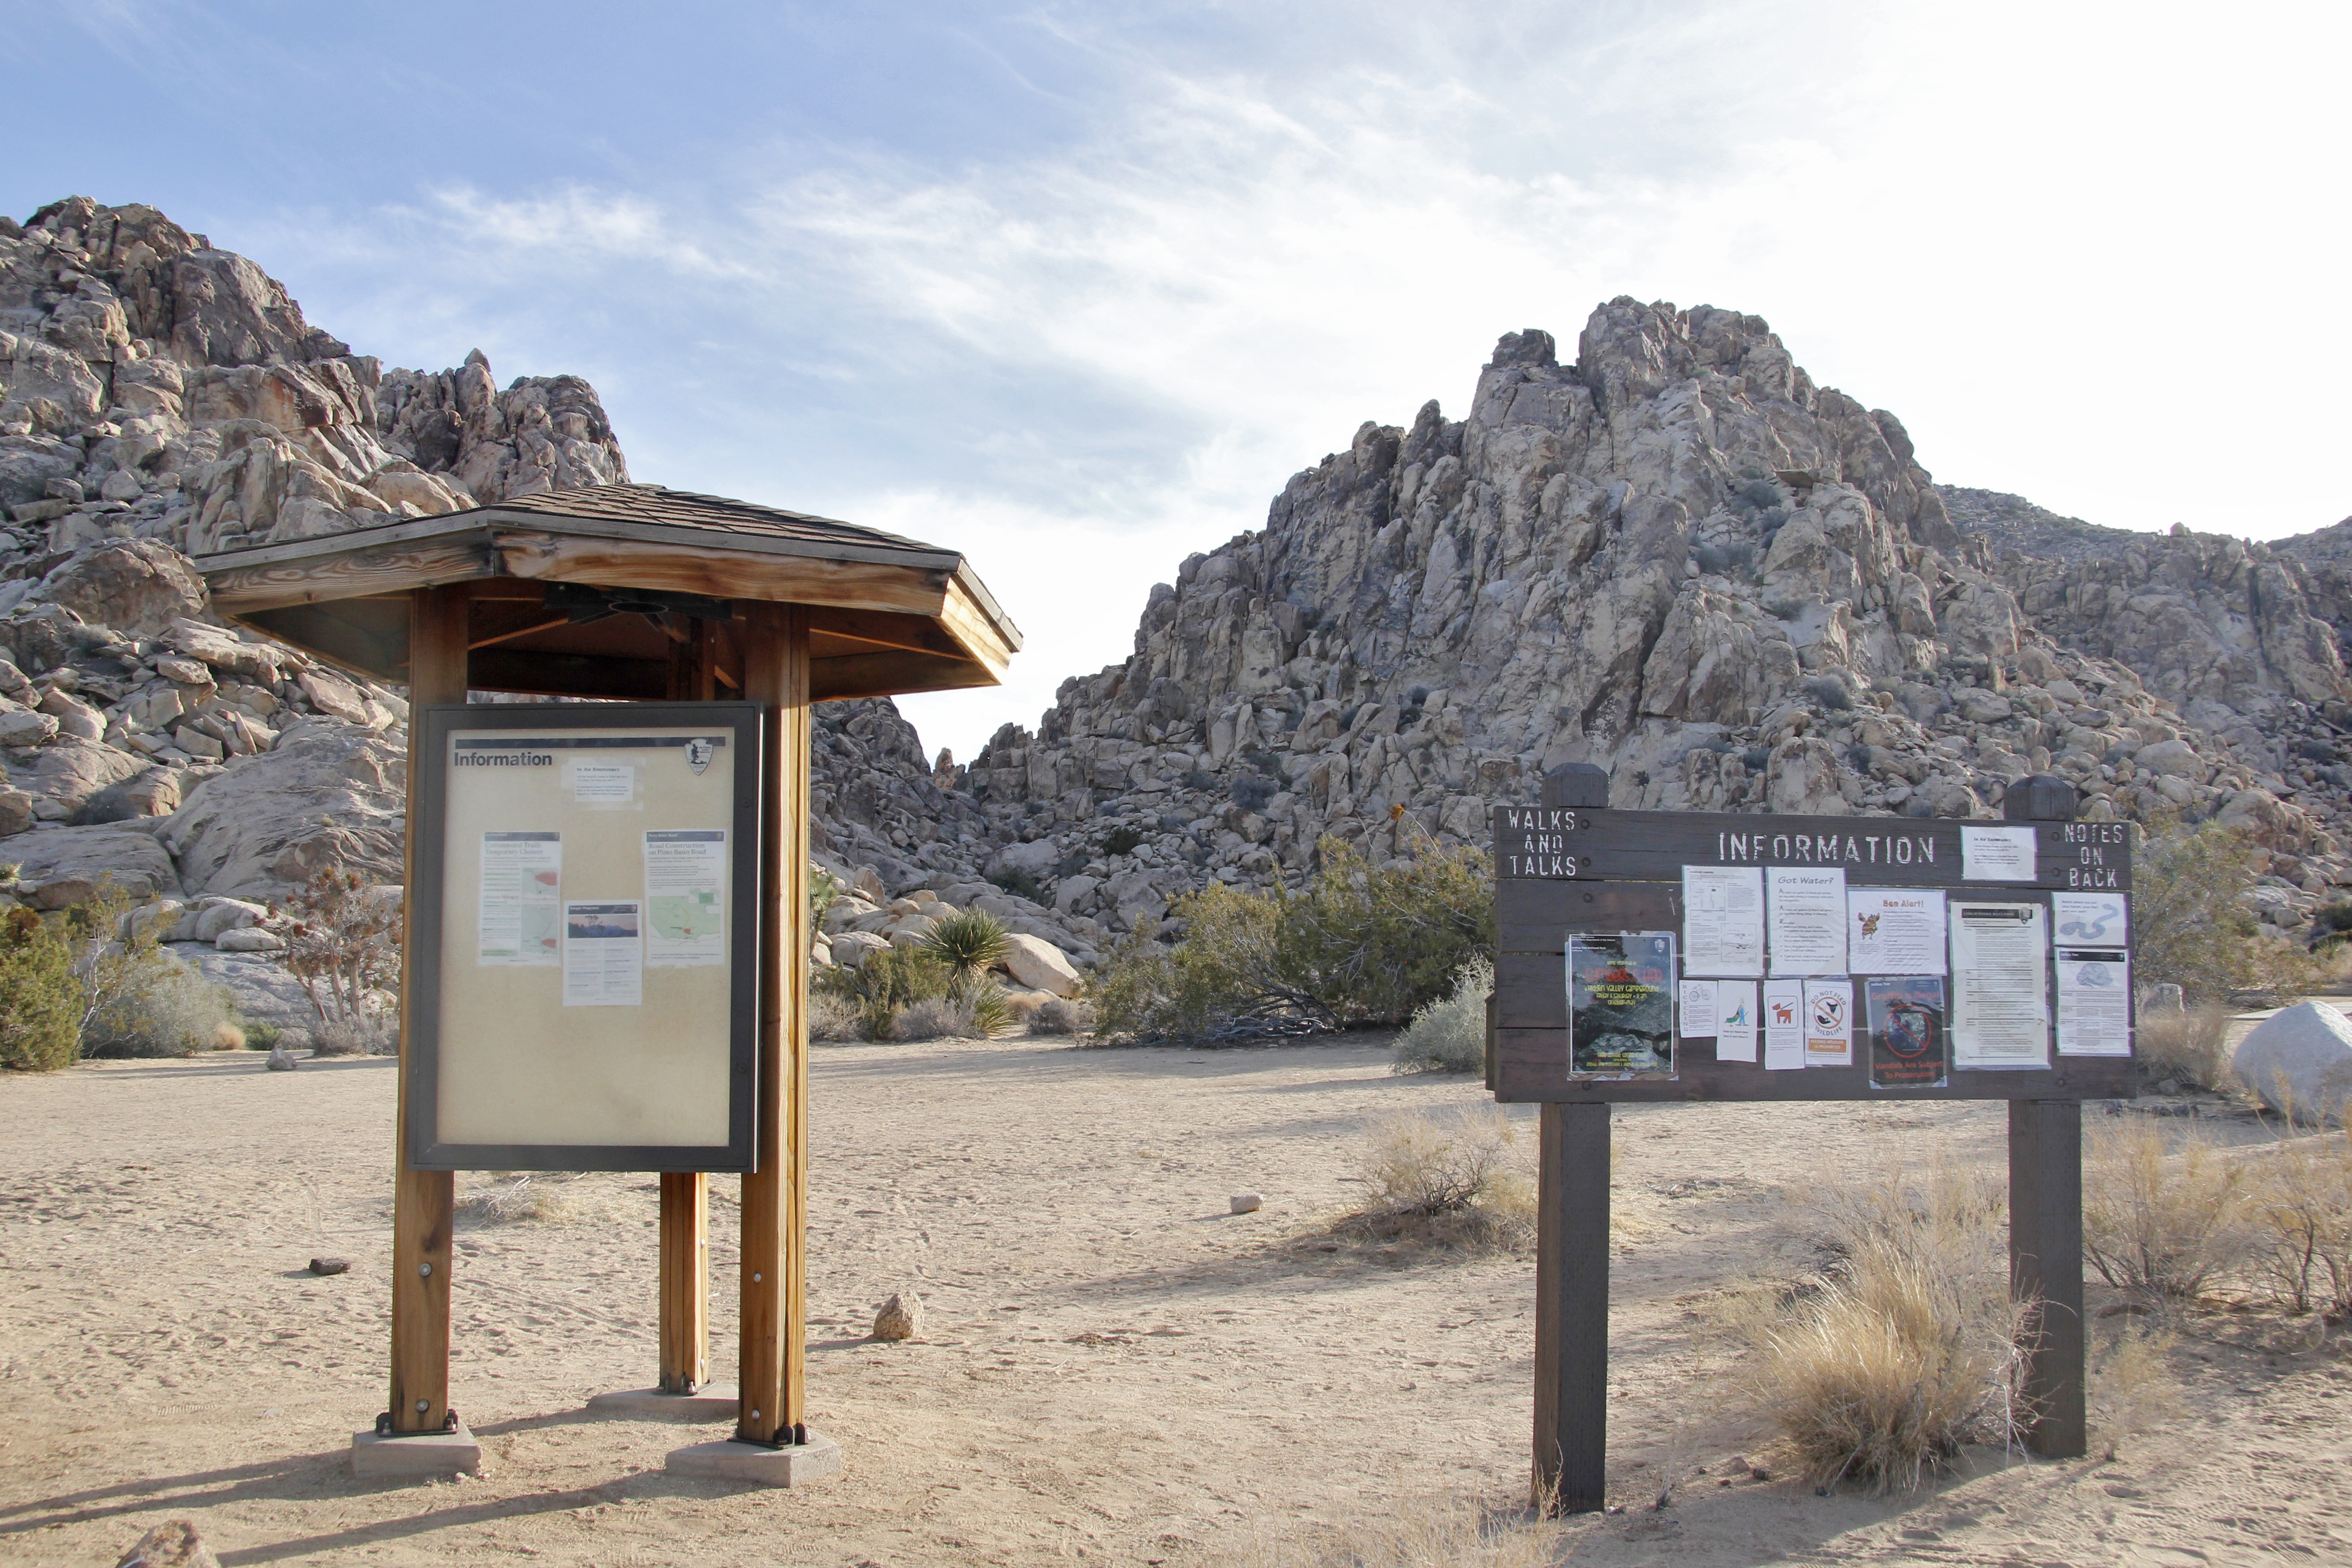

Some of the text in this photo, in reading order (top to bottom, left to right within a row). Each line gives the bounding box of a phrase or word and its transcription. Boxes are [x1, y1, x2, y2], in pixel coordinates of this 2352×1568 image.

[454, 752, 552, 766] Information
[1509, 810, 1575, 830] WALKS
[2065, 824, 2122, 843] NOTES
[1524, 834, 1562, 854] AND
[1719, 832, 1934, 864] INFORMATION
[2081, 847, 2102, 865] ON
[1510, 856, 1576, 876] TALKS
[2069, 868, 2117, 887] BACK
[1901, 900, 1924, 908] Alert!
[1810, 995, 1819, 1004] DO
[1834, 992, 1846, 1005] FEED
[1872, 991, 1903, 1000] Graffiti
[1915, 990, 1940, 1001] Illegal
[1815, 1025, 1843, 1036] WILDLIFE
